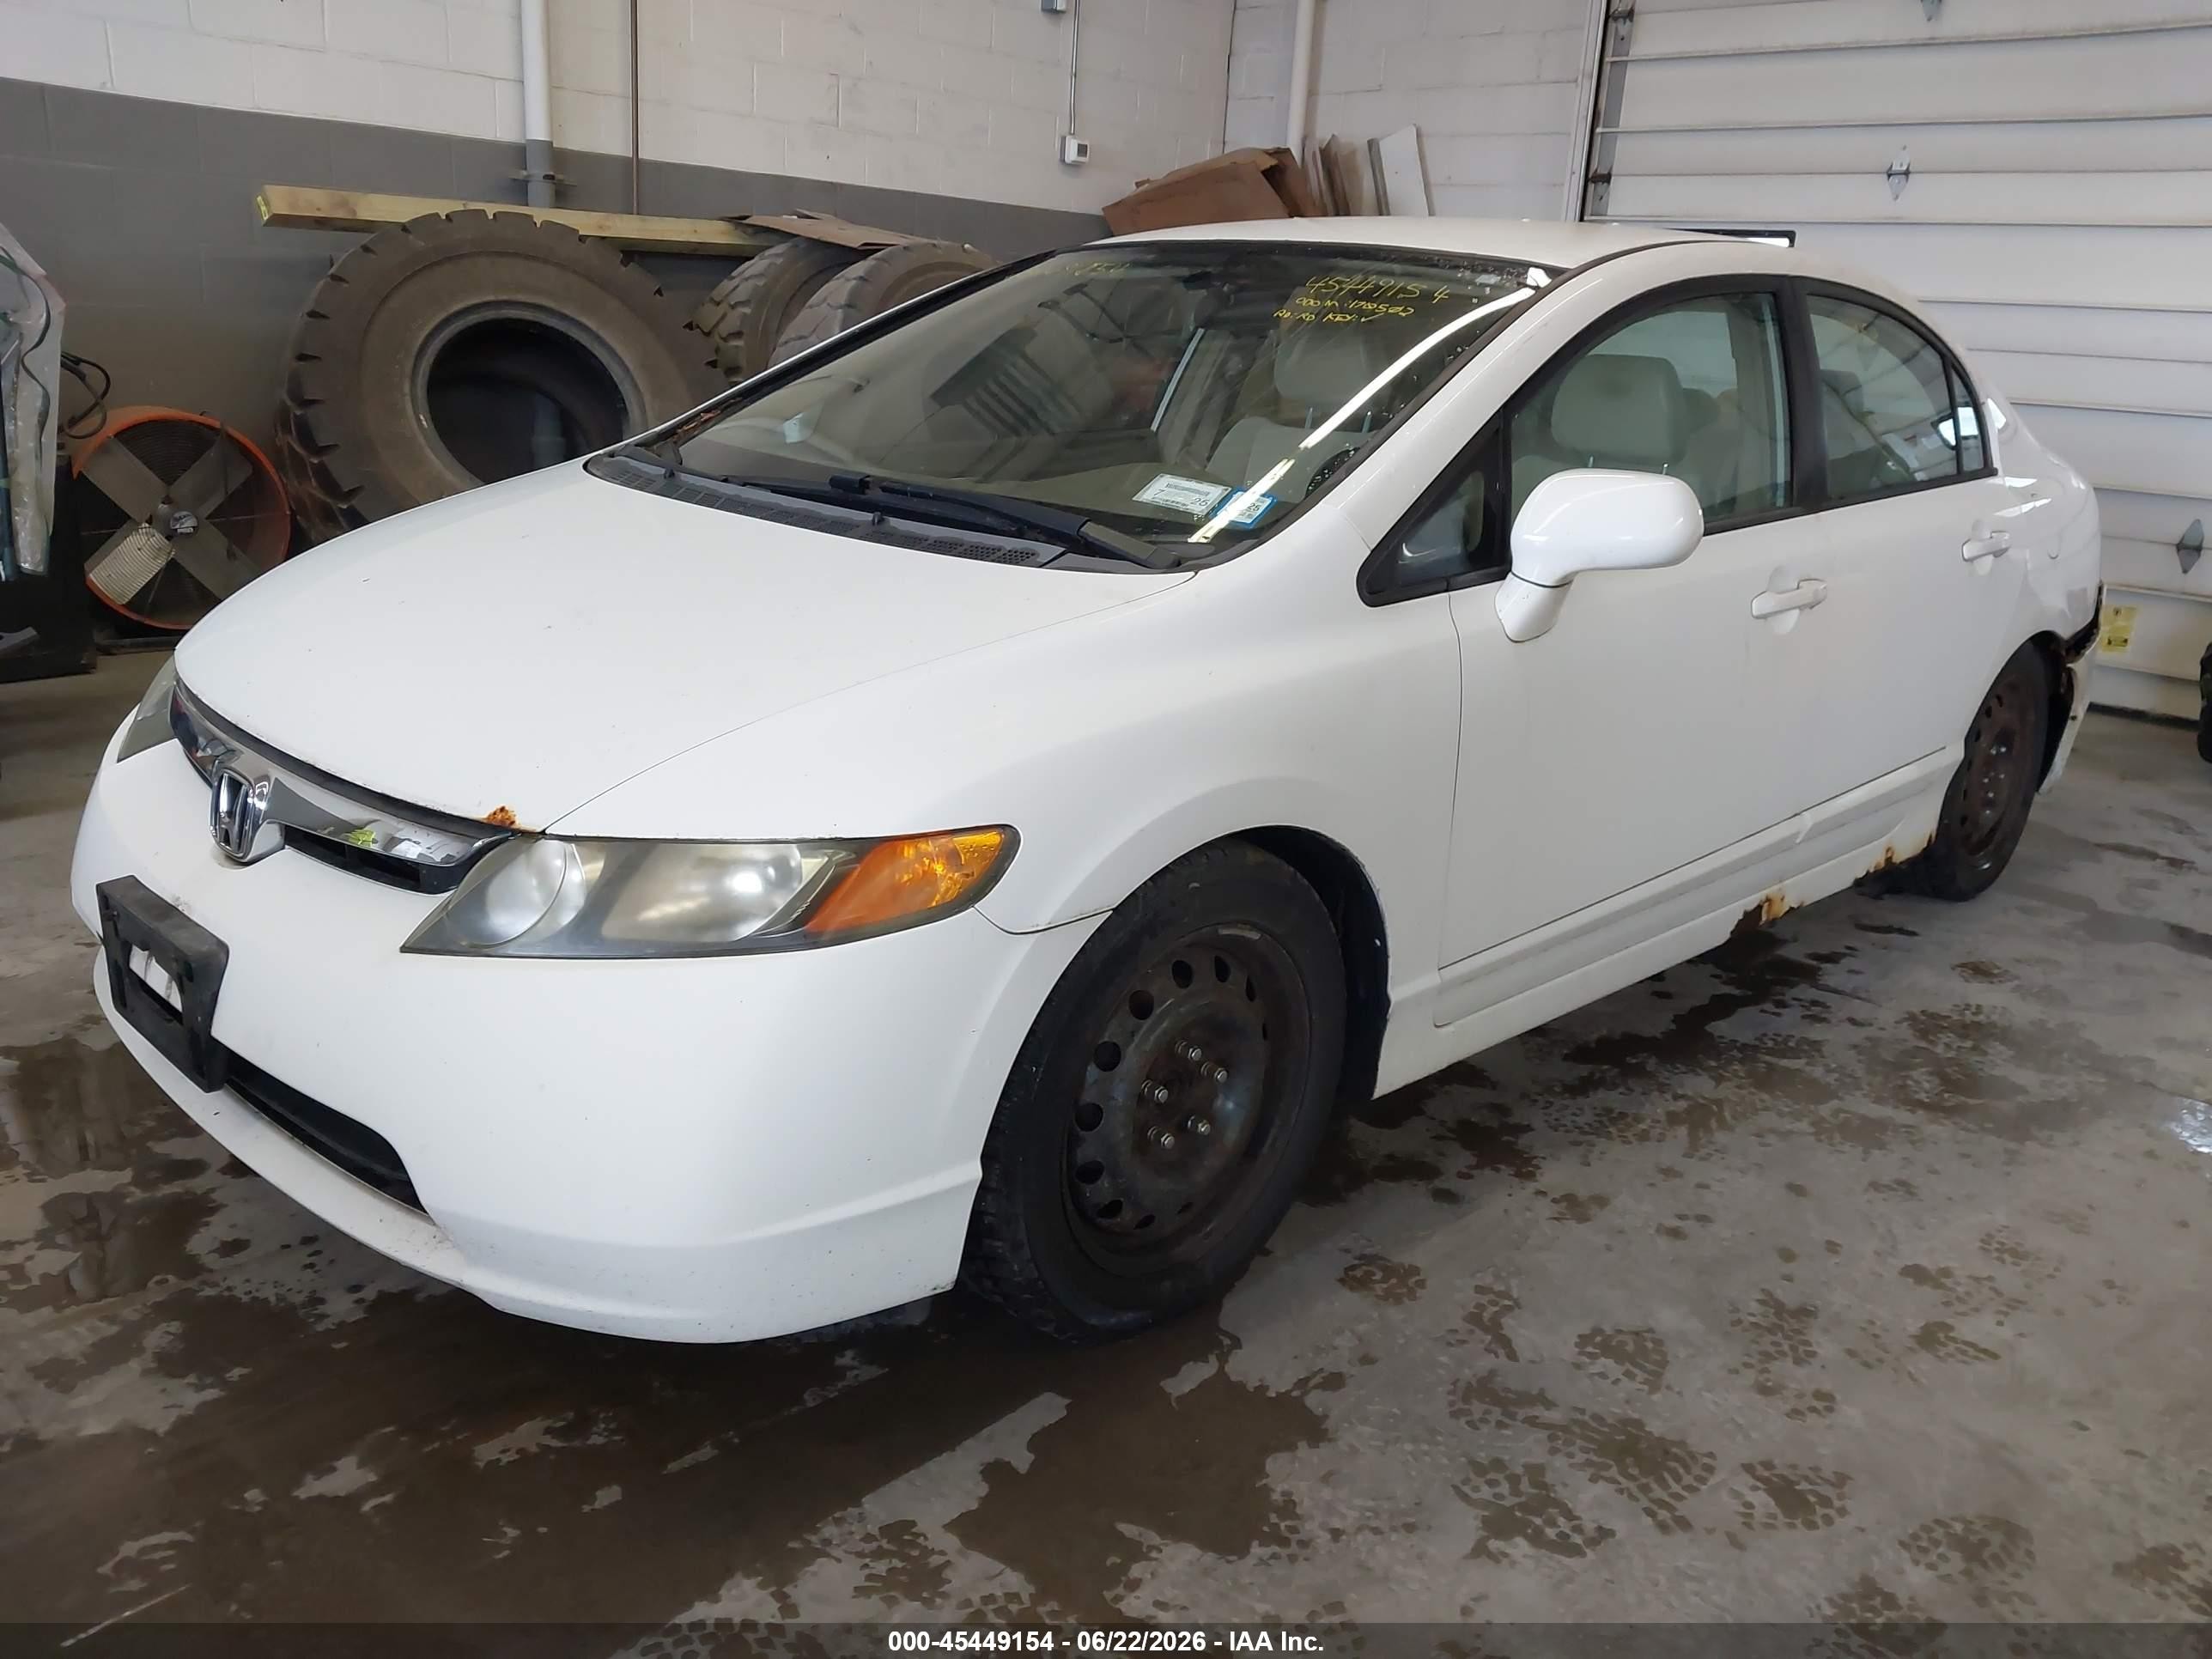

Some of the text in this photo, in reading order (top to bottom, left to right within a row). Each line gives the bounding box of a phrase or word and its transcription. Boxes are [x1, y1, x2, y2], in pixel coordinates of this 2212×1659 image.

[1153, 488, 1166, 496] 7
[1190, 497, 1211, 507] 25
[1247, 502, 1261, 512] 25
